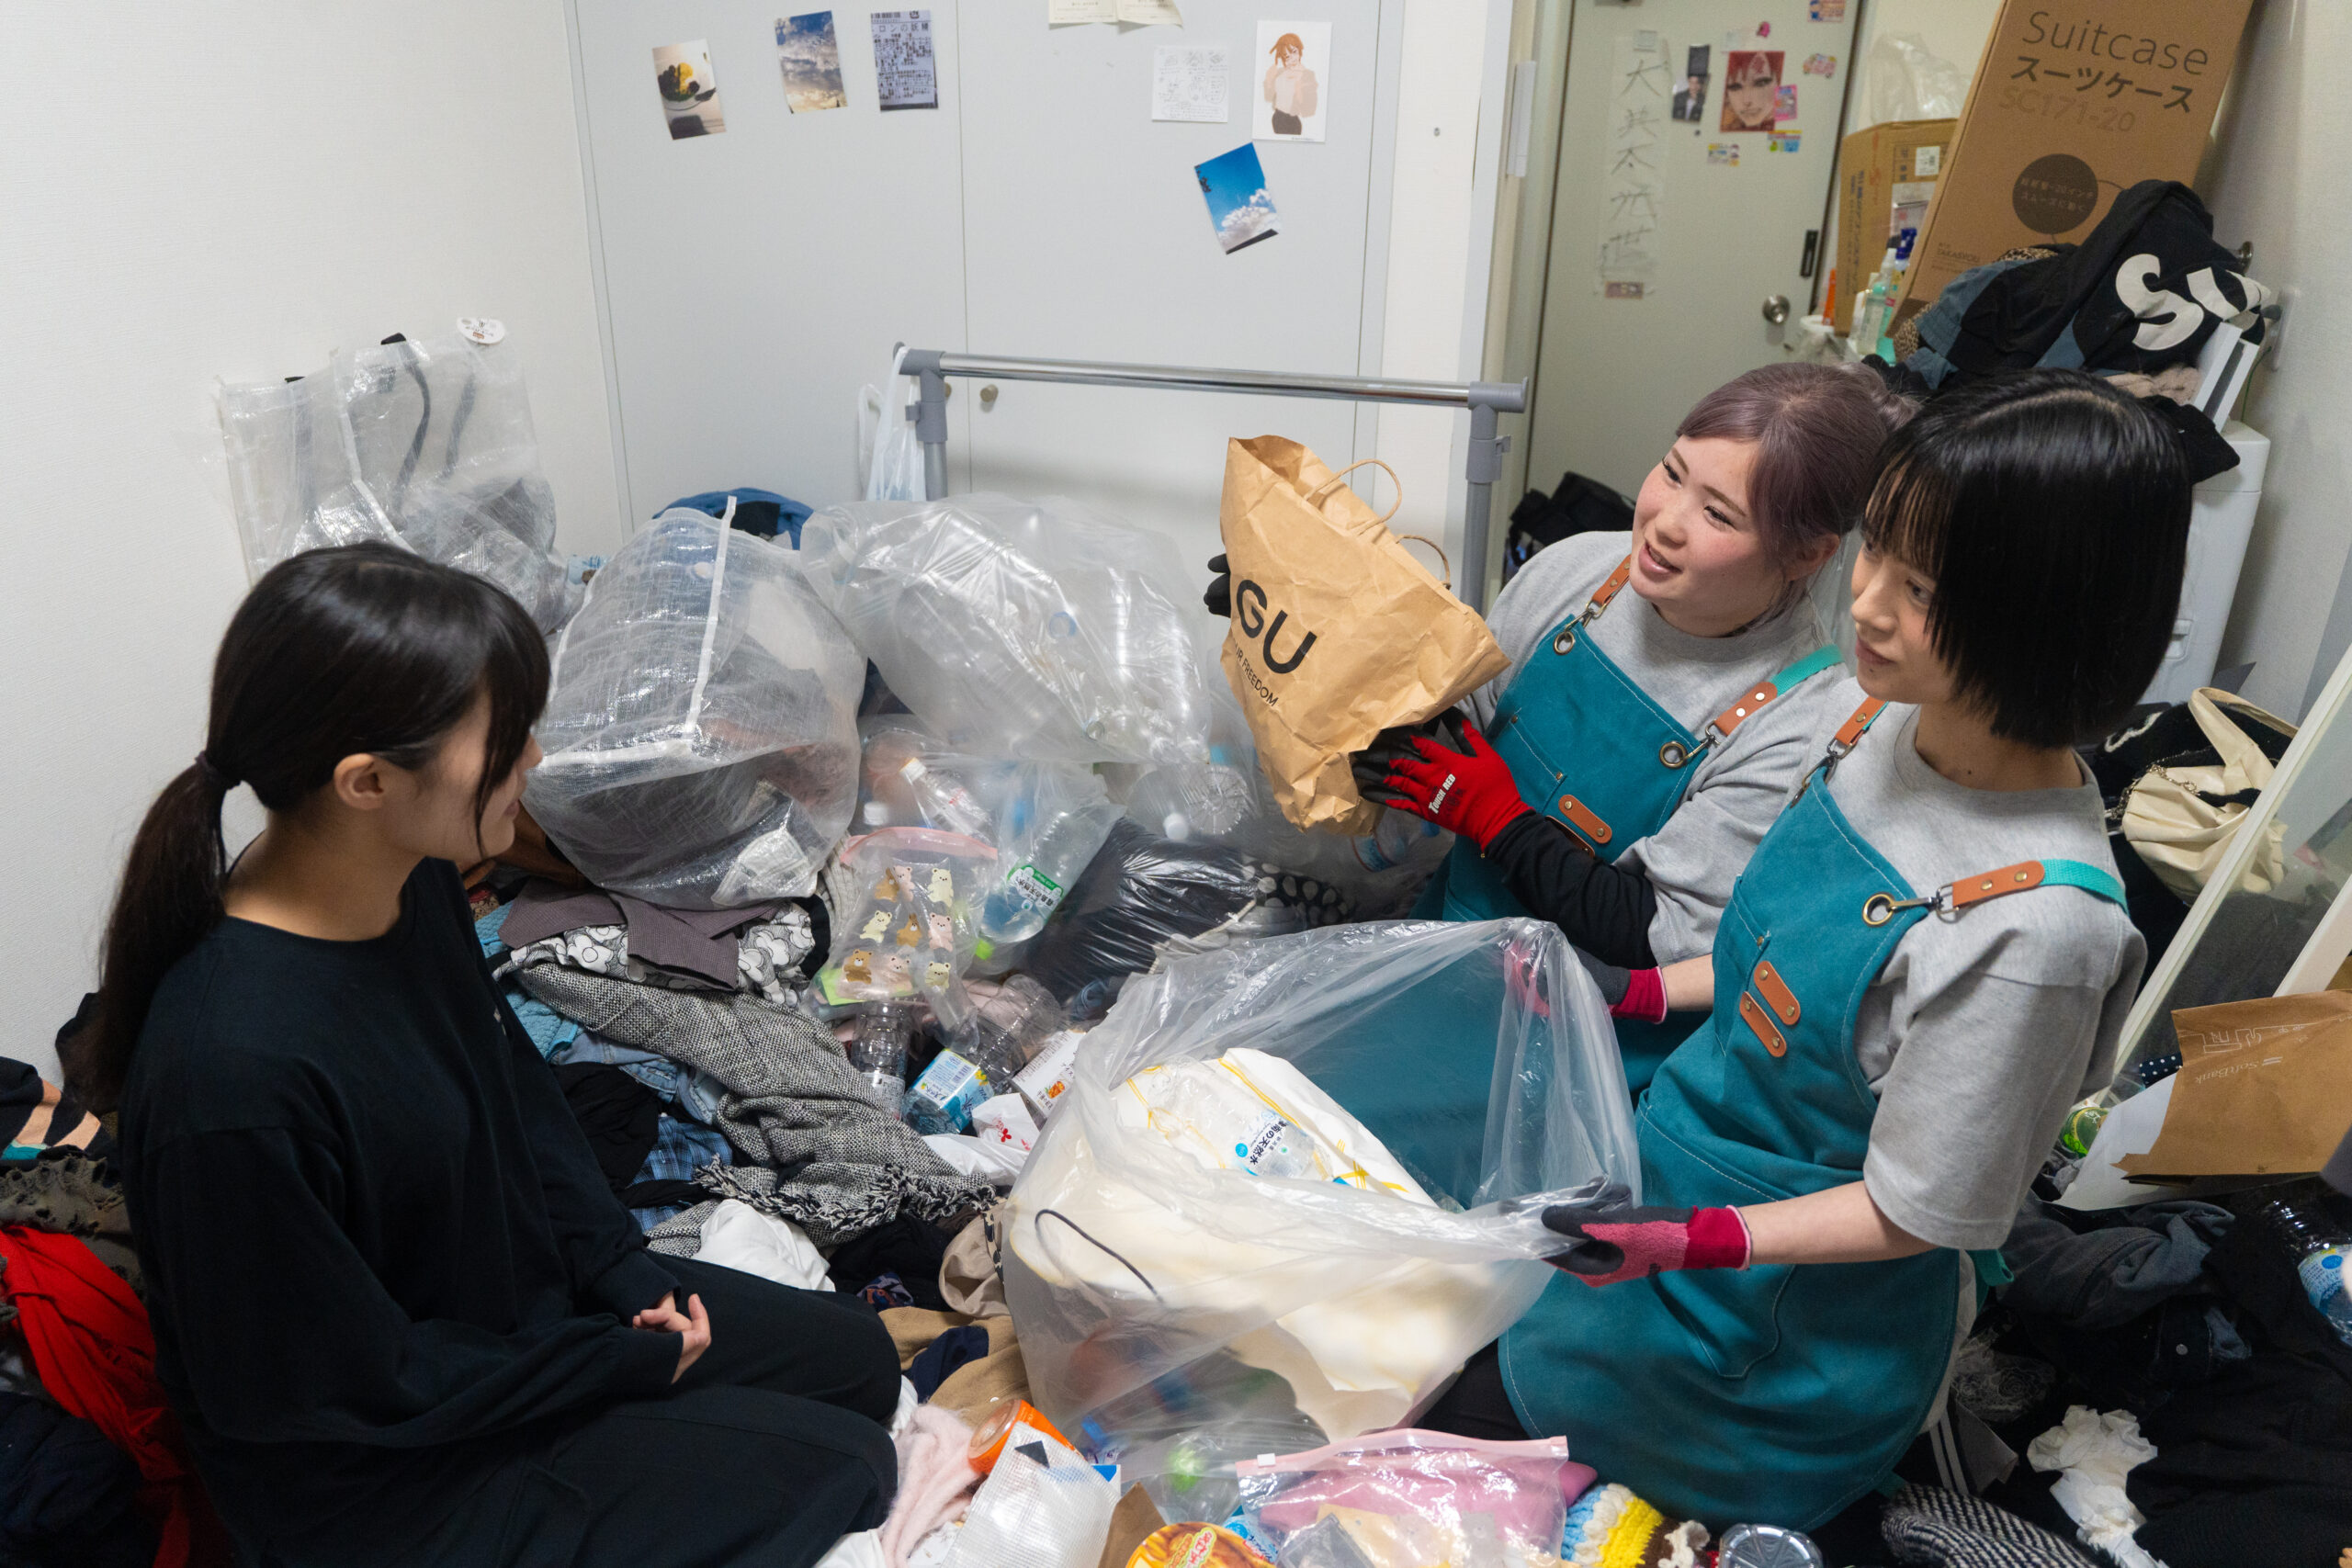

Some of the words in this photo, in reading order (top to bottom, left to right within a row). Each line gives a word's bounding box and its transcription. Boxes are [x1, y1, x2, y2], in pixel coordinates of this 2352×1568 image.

[2022, 11, 2209, 75] Suitcase
[1999, 85, 2136, 132] SC171-20
[2010, 55, 2193, 113] スーツケース
[1237, 579, 1317, 674] GU
[1241, 658, 1280, 707] FREEDOM
[1428, 788, 1447, 815] TOUGH
[1442, 773, 1456, 792] RED
[2195, 1061, 2260, 1085] SoftBank
